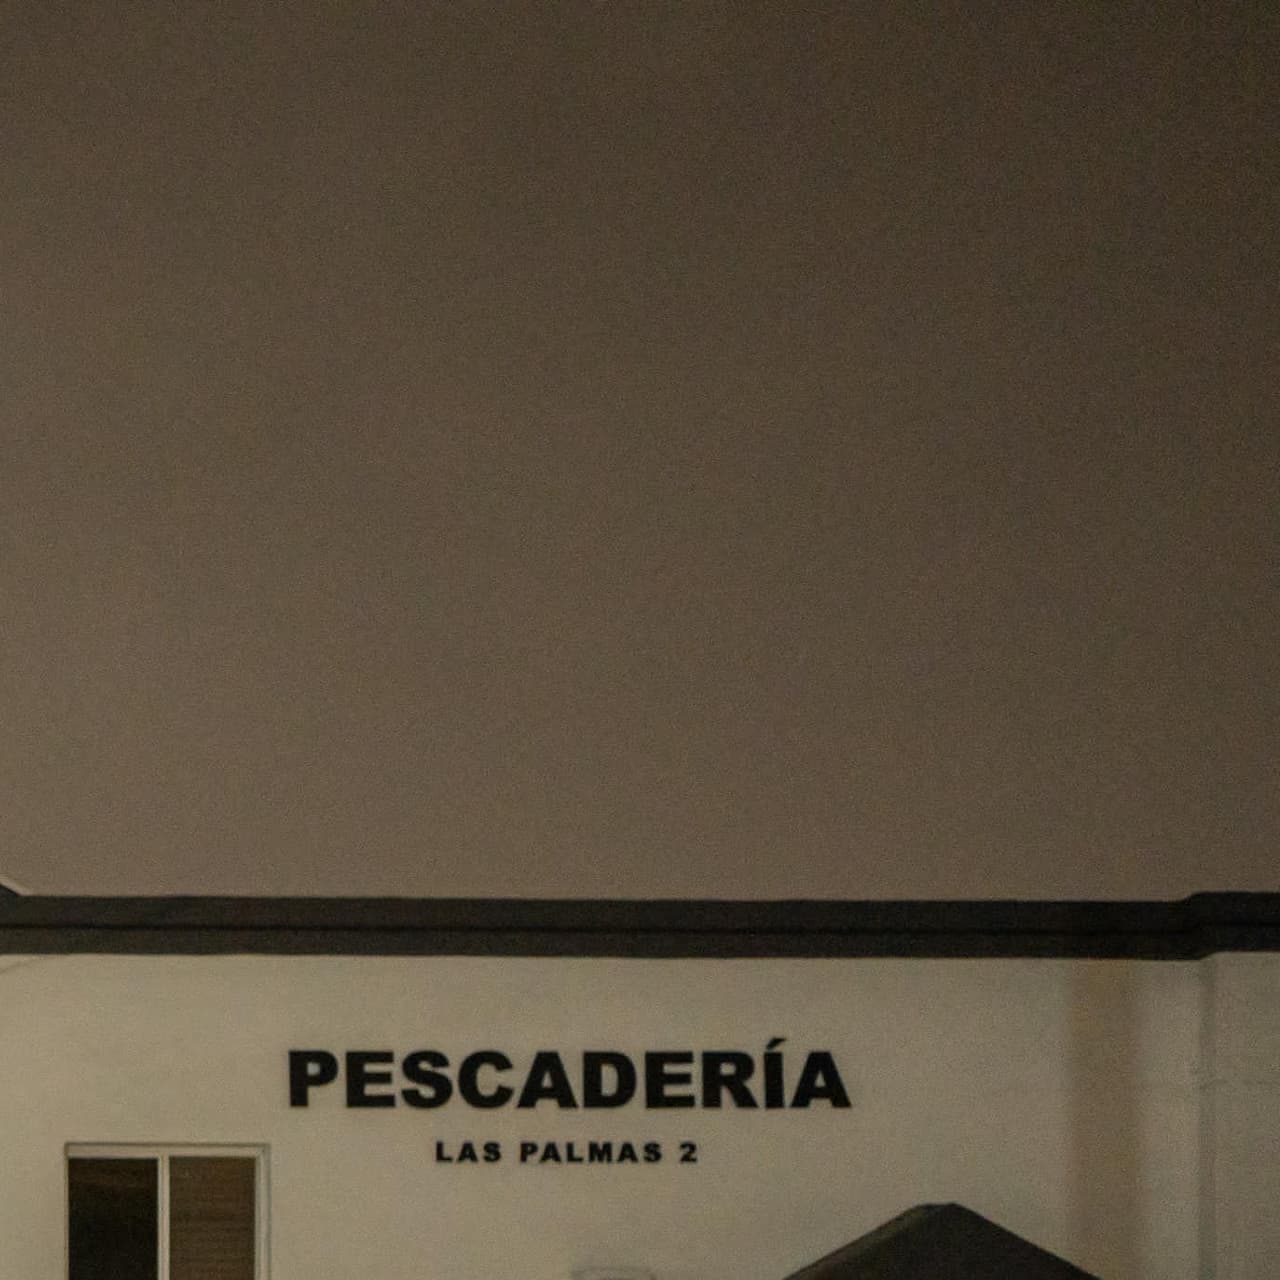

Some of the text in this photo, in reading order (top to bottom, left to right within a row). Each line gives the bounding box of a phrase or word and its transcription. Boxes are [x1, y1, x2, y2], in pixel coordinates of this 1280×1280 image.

[287, 1038, 853, 1110] PESCADERÍA
[435, 1141, 699, 1164] LAS PALMAS 2
